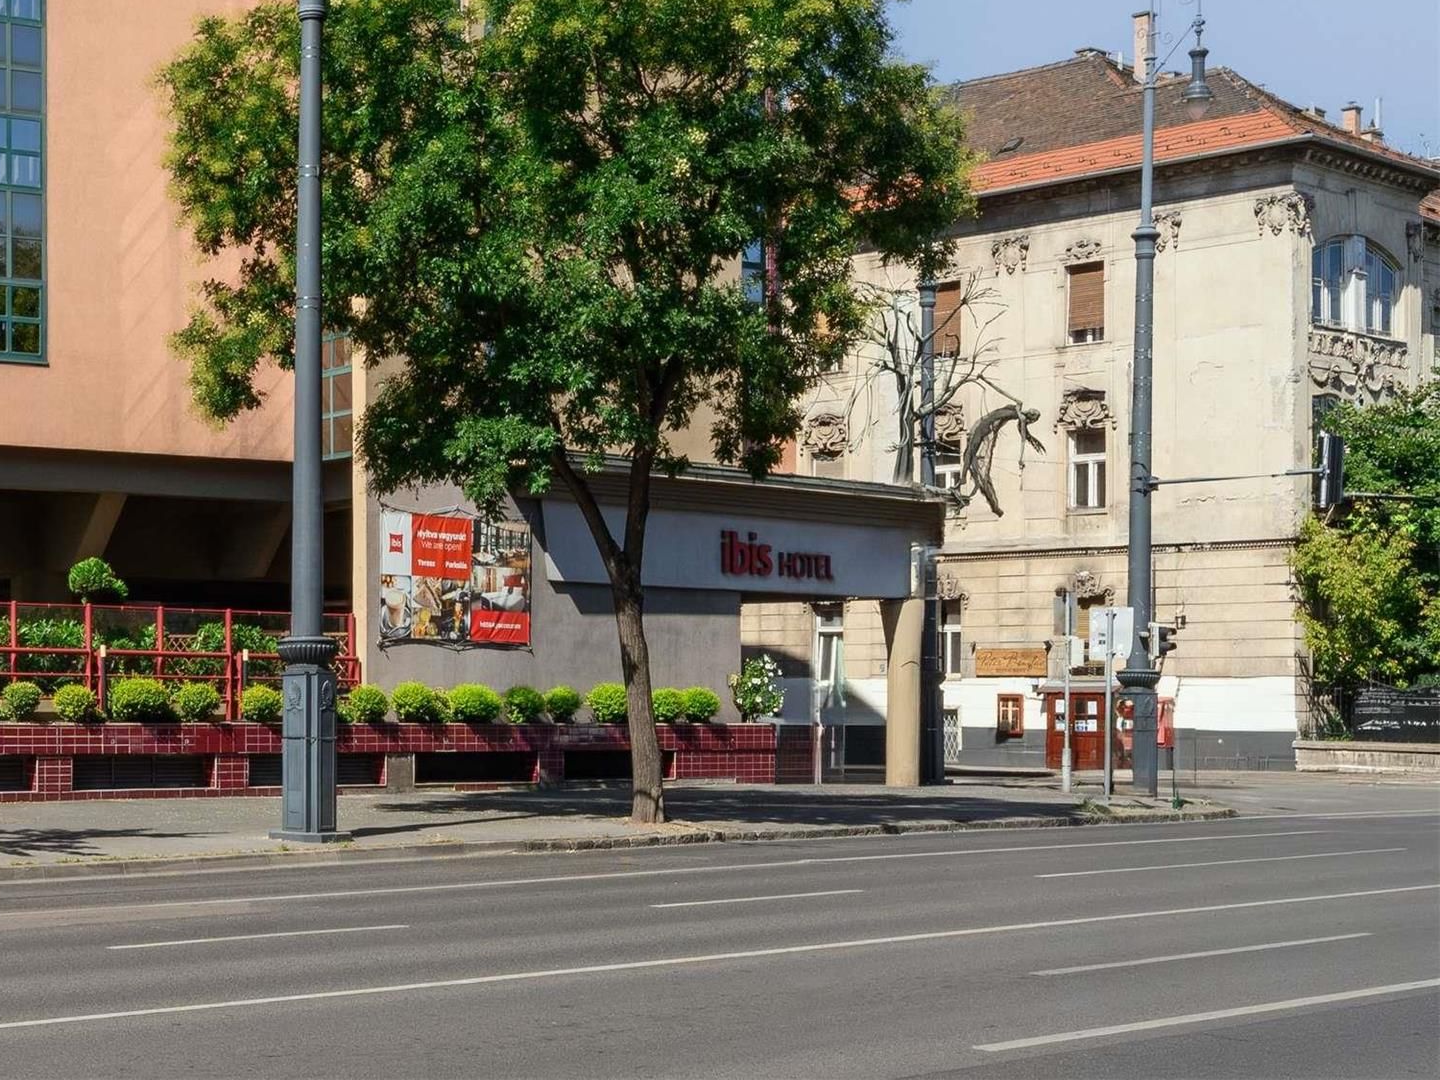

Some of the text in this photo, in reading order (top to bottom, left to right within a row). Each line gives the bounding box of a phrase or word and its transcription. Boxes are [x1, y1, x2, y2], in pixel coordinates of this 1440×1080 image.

[391, 538, 402, 547] ibis
[421, 540, 432, 549] We
[433, 542, 443, 550] are
[721, 530, 834, 581] ibis HOTEL
